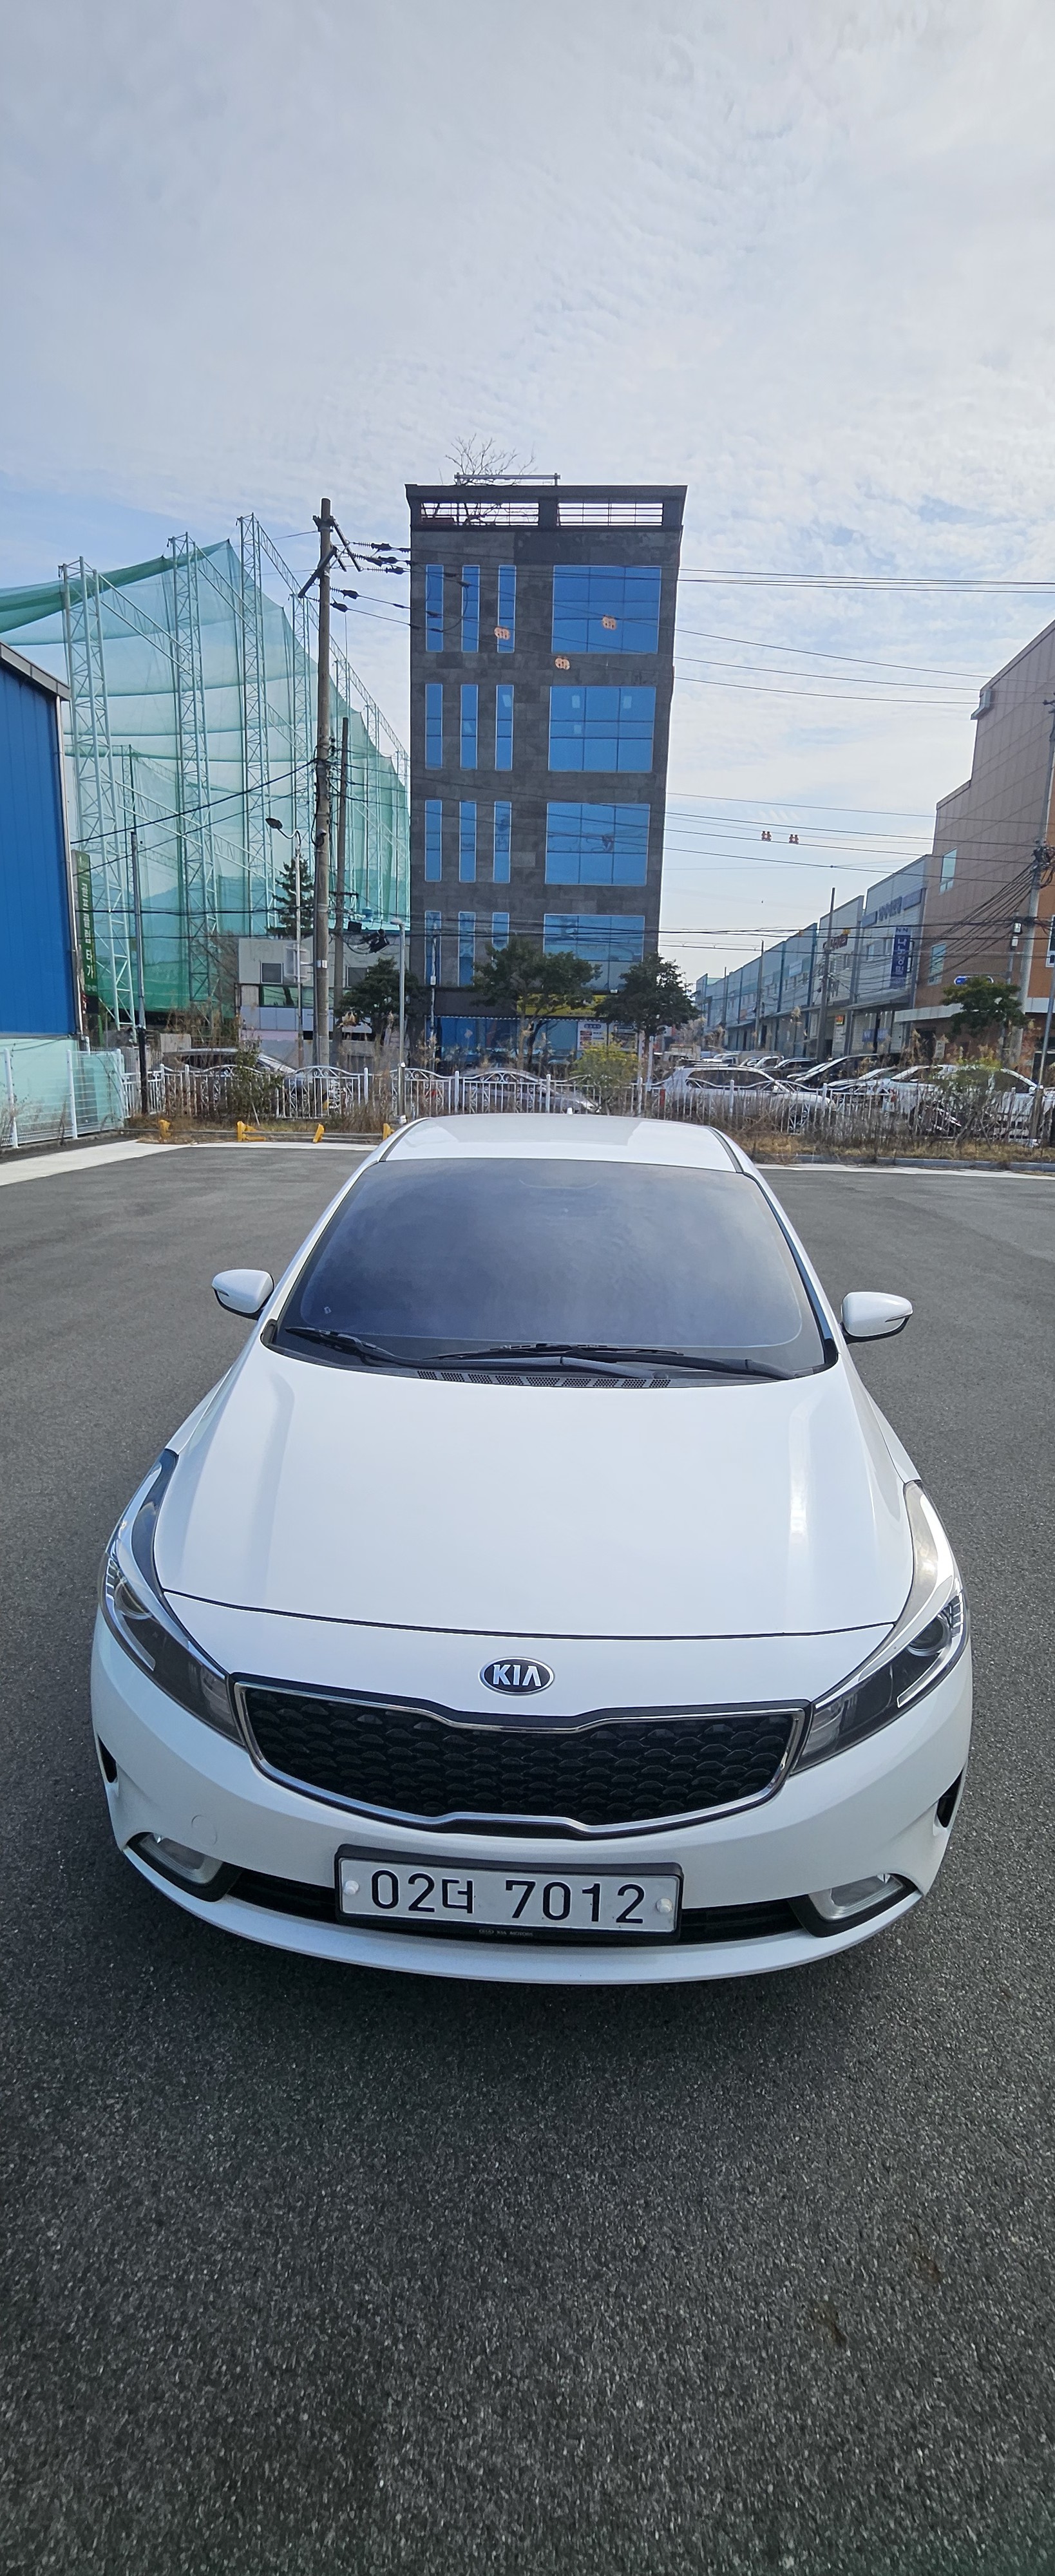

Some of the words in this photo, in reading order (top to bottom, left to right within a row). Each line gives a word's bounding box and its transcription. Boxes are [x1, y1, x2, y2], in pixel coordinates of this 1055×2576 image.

[493, 1664, 542, 1687] KIA
[371, 1870, 474, 1914] 02더
[506, 1879, 645, 1924] 7012
